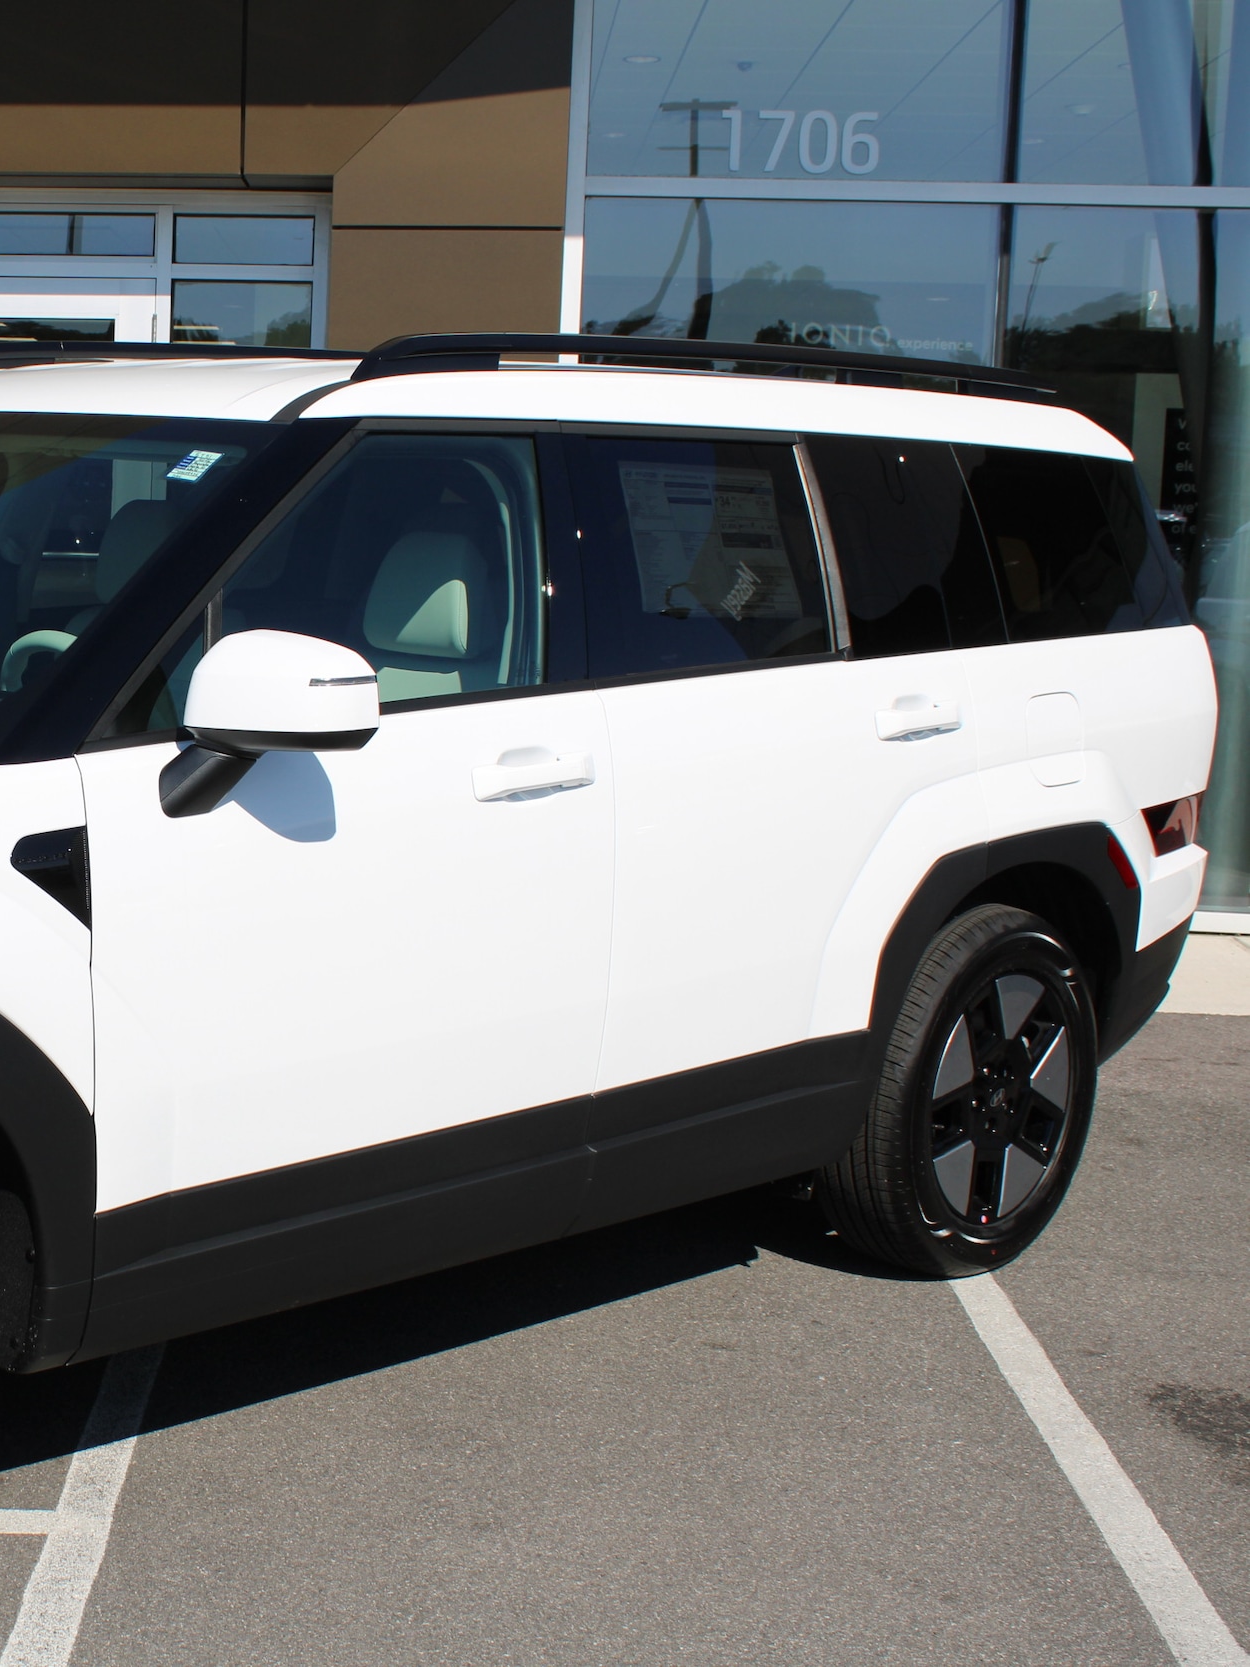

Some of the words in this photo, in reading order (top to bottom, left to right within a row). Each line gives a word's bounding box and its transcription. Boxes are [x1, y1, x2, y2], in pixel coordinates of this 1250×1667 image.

[721, 109, 880, 175] 1706
[789, 321, 891, 347] IONIQ
[897, 339, 974, 352] experience
